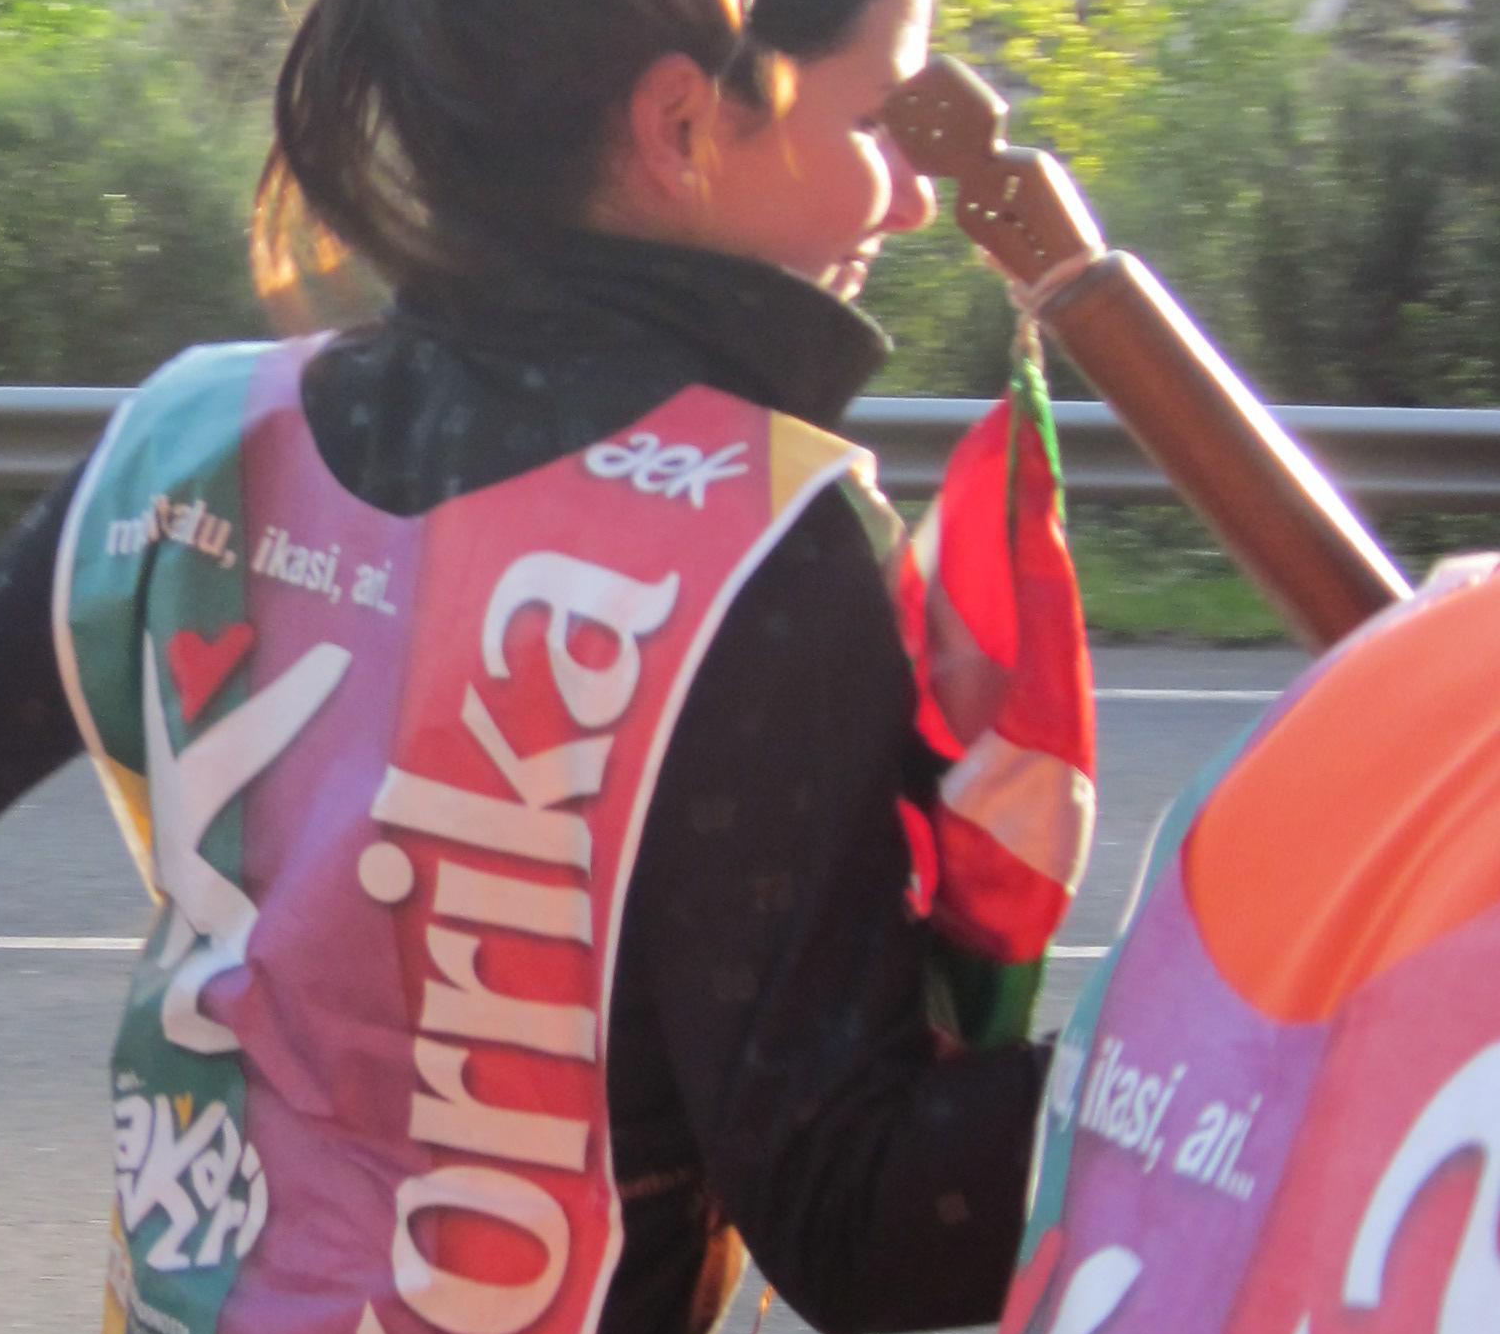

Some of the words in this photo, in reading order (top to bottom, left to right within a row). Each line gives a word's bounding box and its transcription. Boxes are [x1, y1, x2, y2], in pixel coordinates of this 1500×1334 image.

[586, 432, 749, 509] aek
[252, 525, 344, 605] ikasi,
[1079, 1037, 1189, 1175] ikasi,
